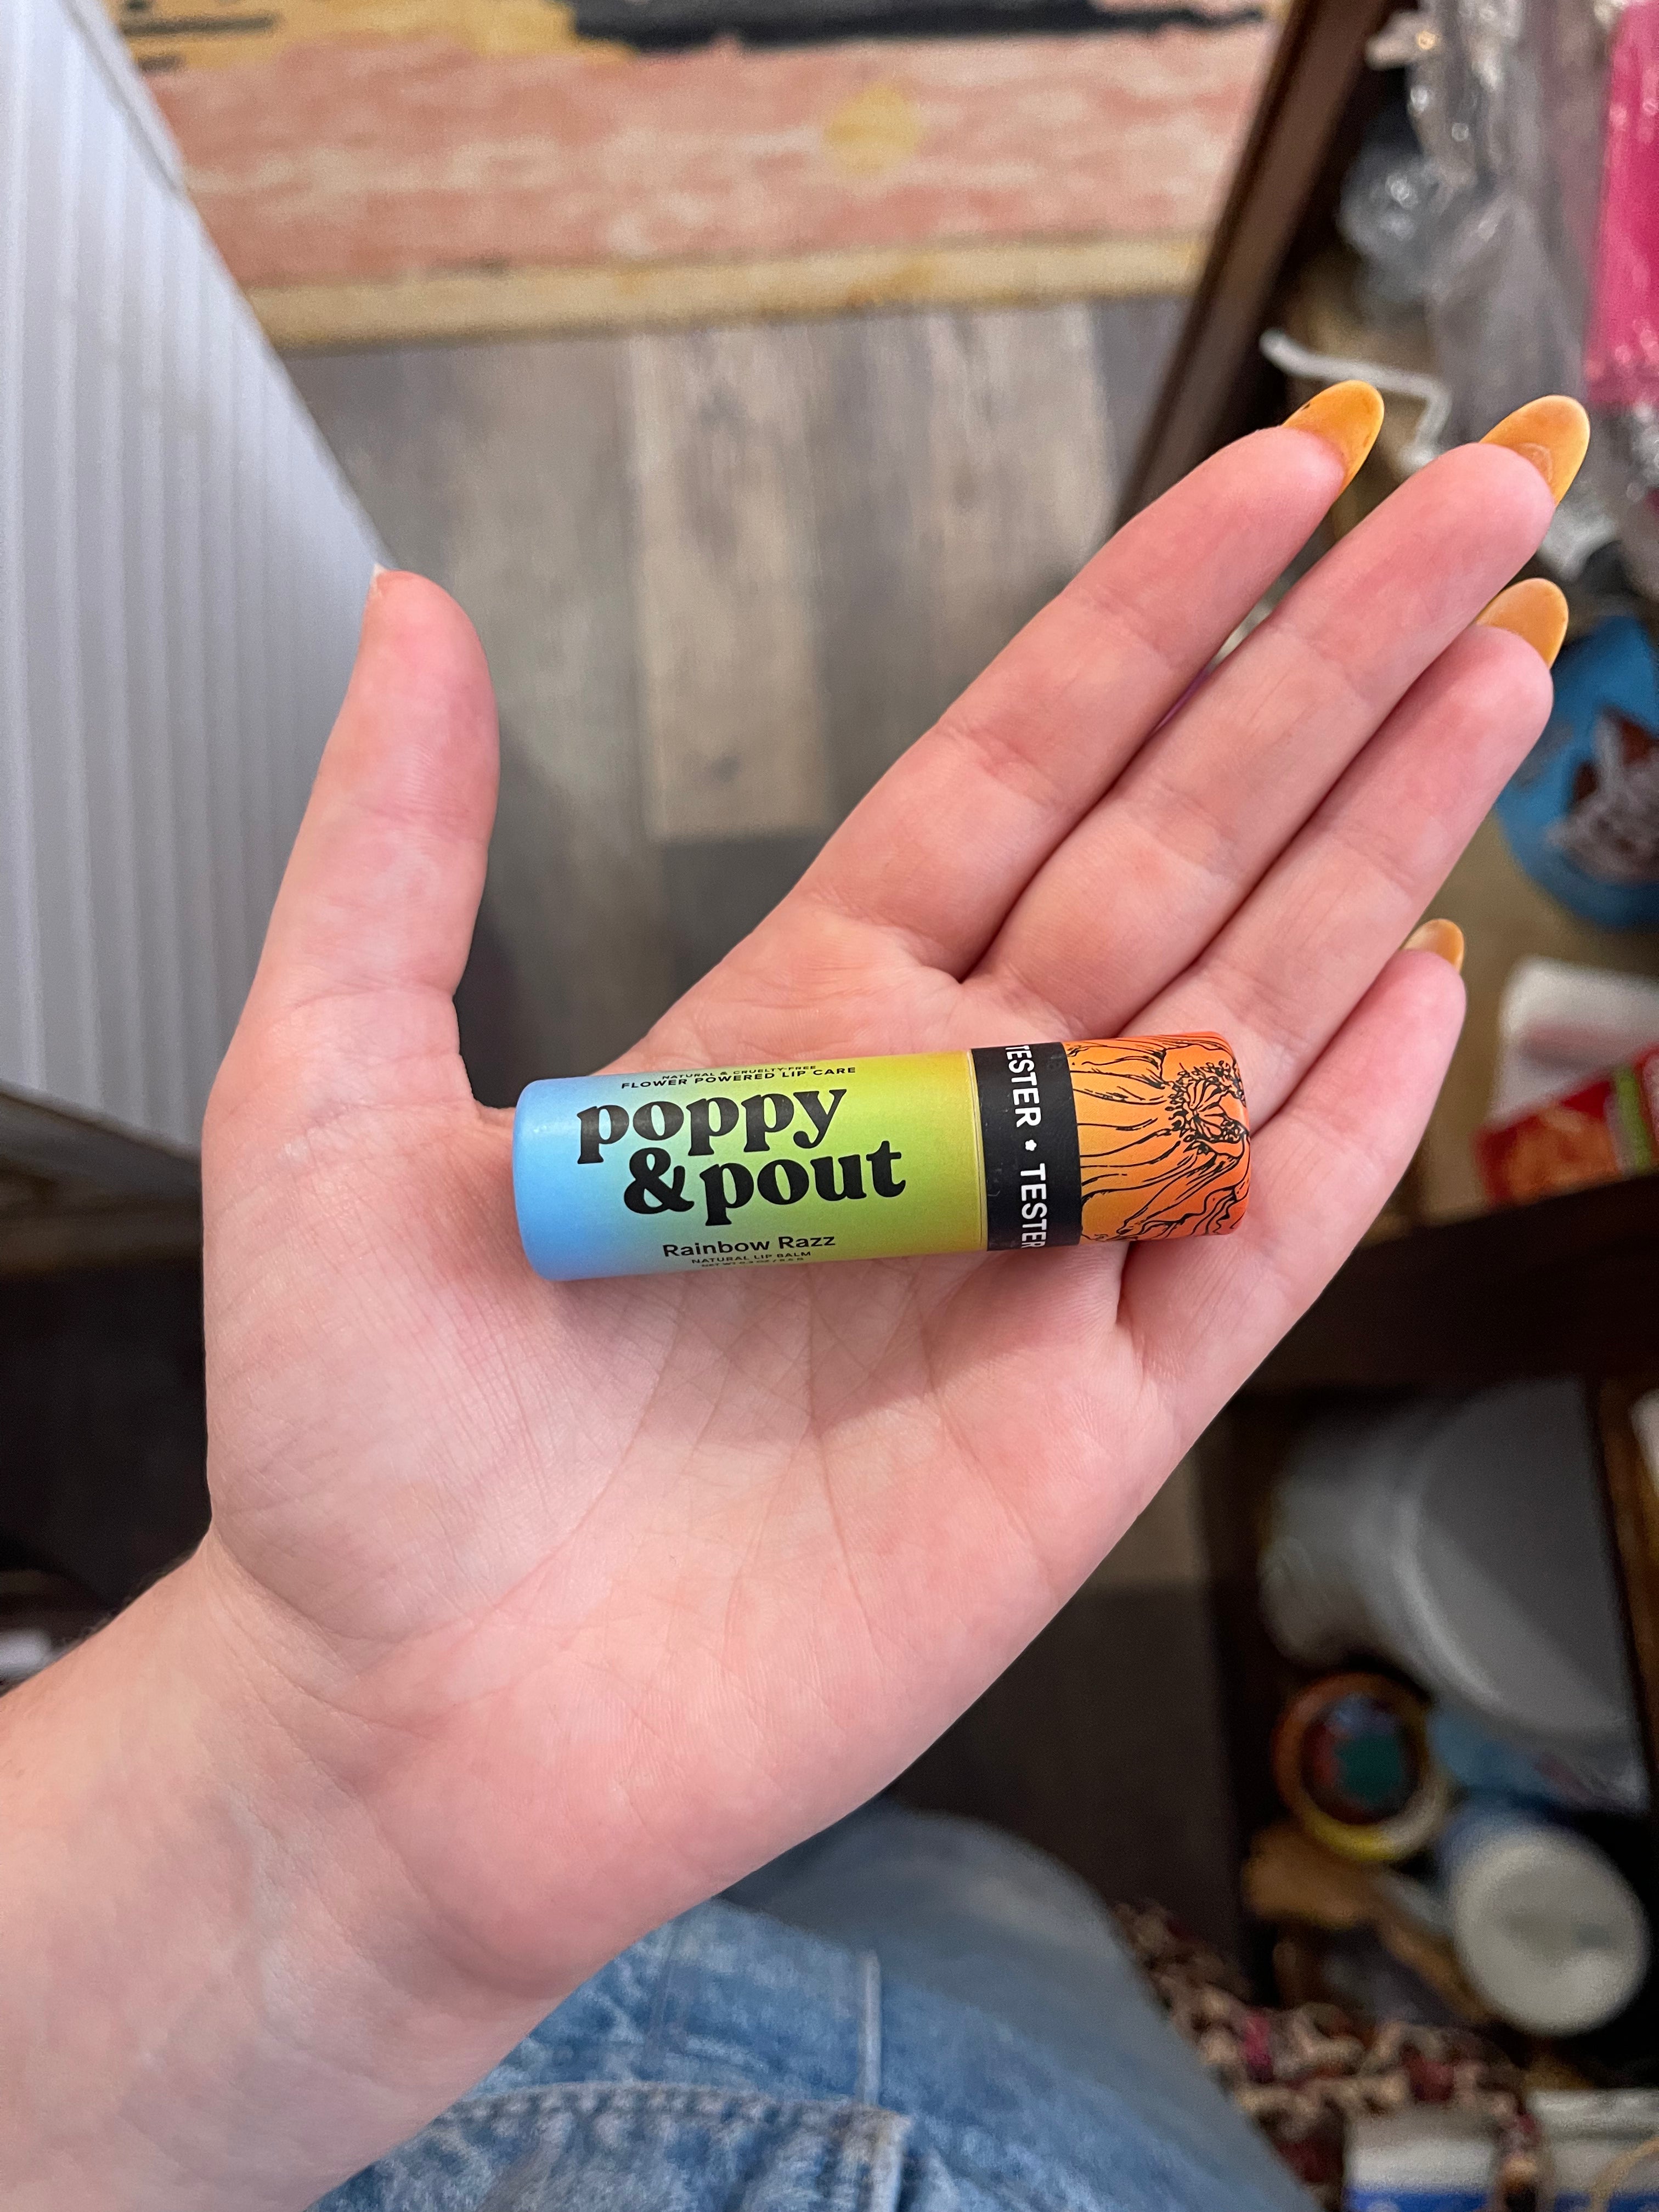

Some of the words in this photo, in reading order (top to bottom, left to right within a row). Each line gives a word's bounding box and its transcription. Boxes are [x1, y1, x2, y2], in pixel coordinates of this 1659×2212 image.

[621, 1079, 687, 1089] FLOWER
[695, 1073, 775, 1084] POWERED
[813, 1067, 856, 1076] CARE
[733, 1065, 816, 1075] CRUELTY-FREE
[1005, 1045, 1041, 1127] TESTER
[577, 1088, 847, 1165] poppy
[623, 1141, 906, 1226] &pout
[1020, 1163, 1047, 1248] TESTER
[662, 1241, 770, 1257] Rainbow
[778, 1236, 836, 1249] Razz
[691, 1255, 750, 1264] NATURAL
